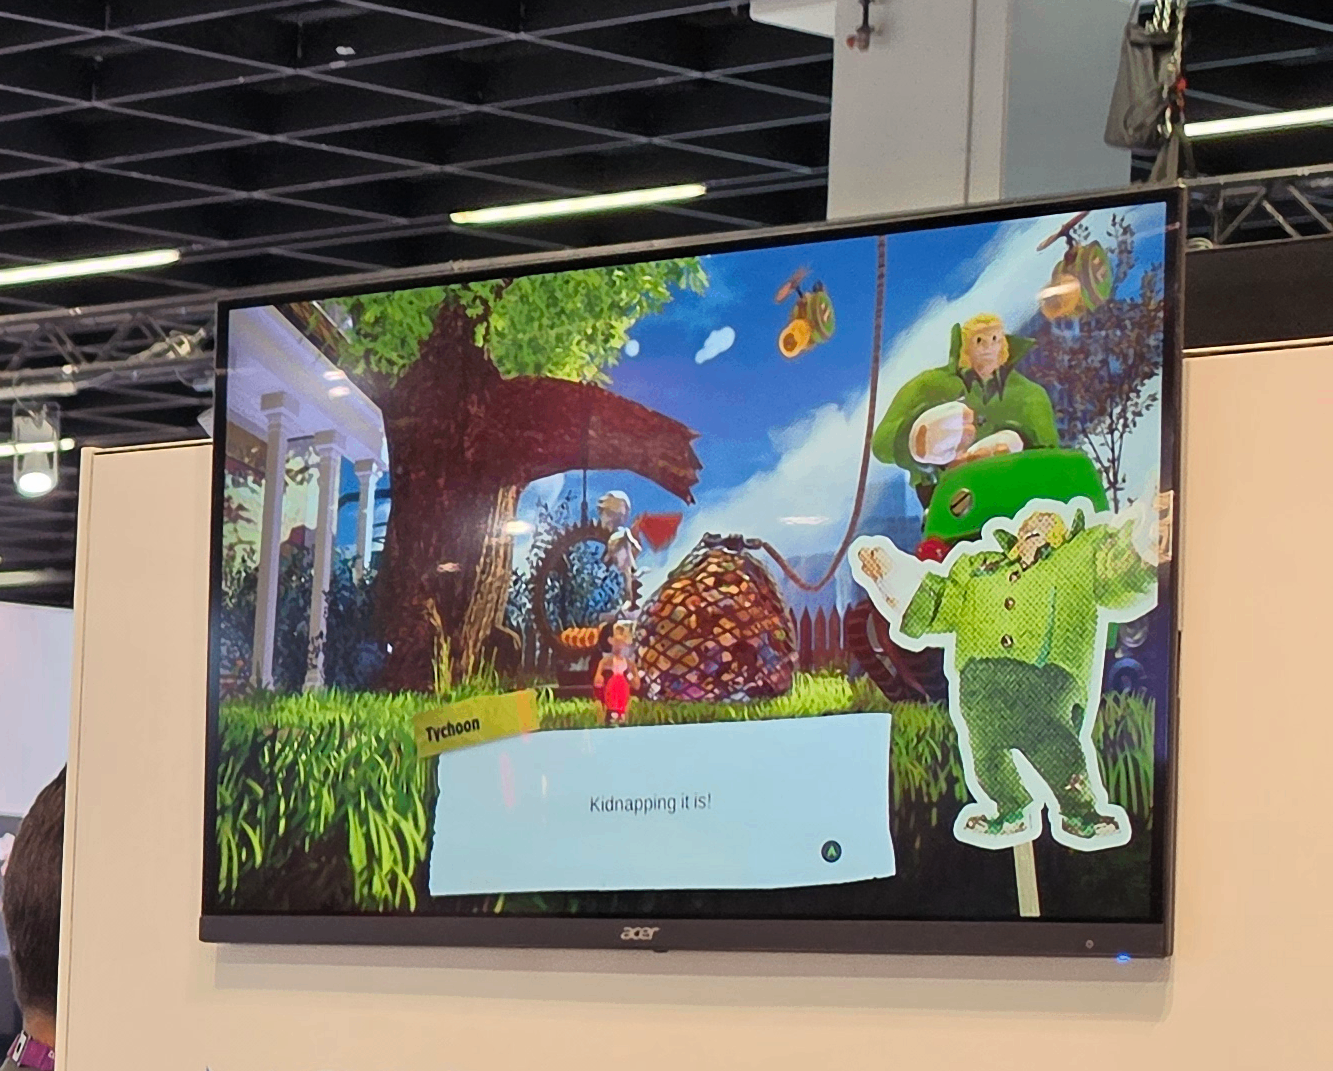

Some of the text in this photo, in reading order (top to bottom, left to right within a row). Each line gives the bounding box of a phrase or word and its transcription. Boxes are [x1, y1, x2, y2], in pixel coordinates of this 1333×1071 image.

[425, 718, 480, 742] Tychoon
[589, 792, 712, 815] Kidnapping it is!
[620, 926, 660, 941] acer
